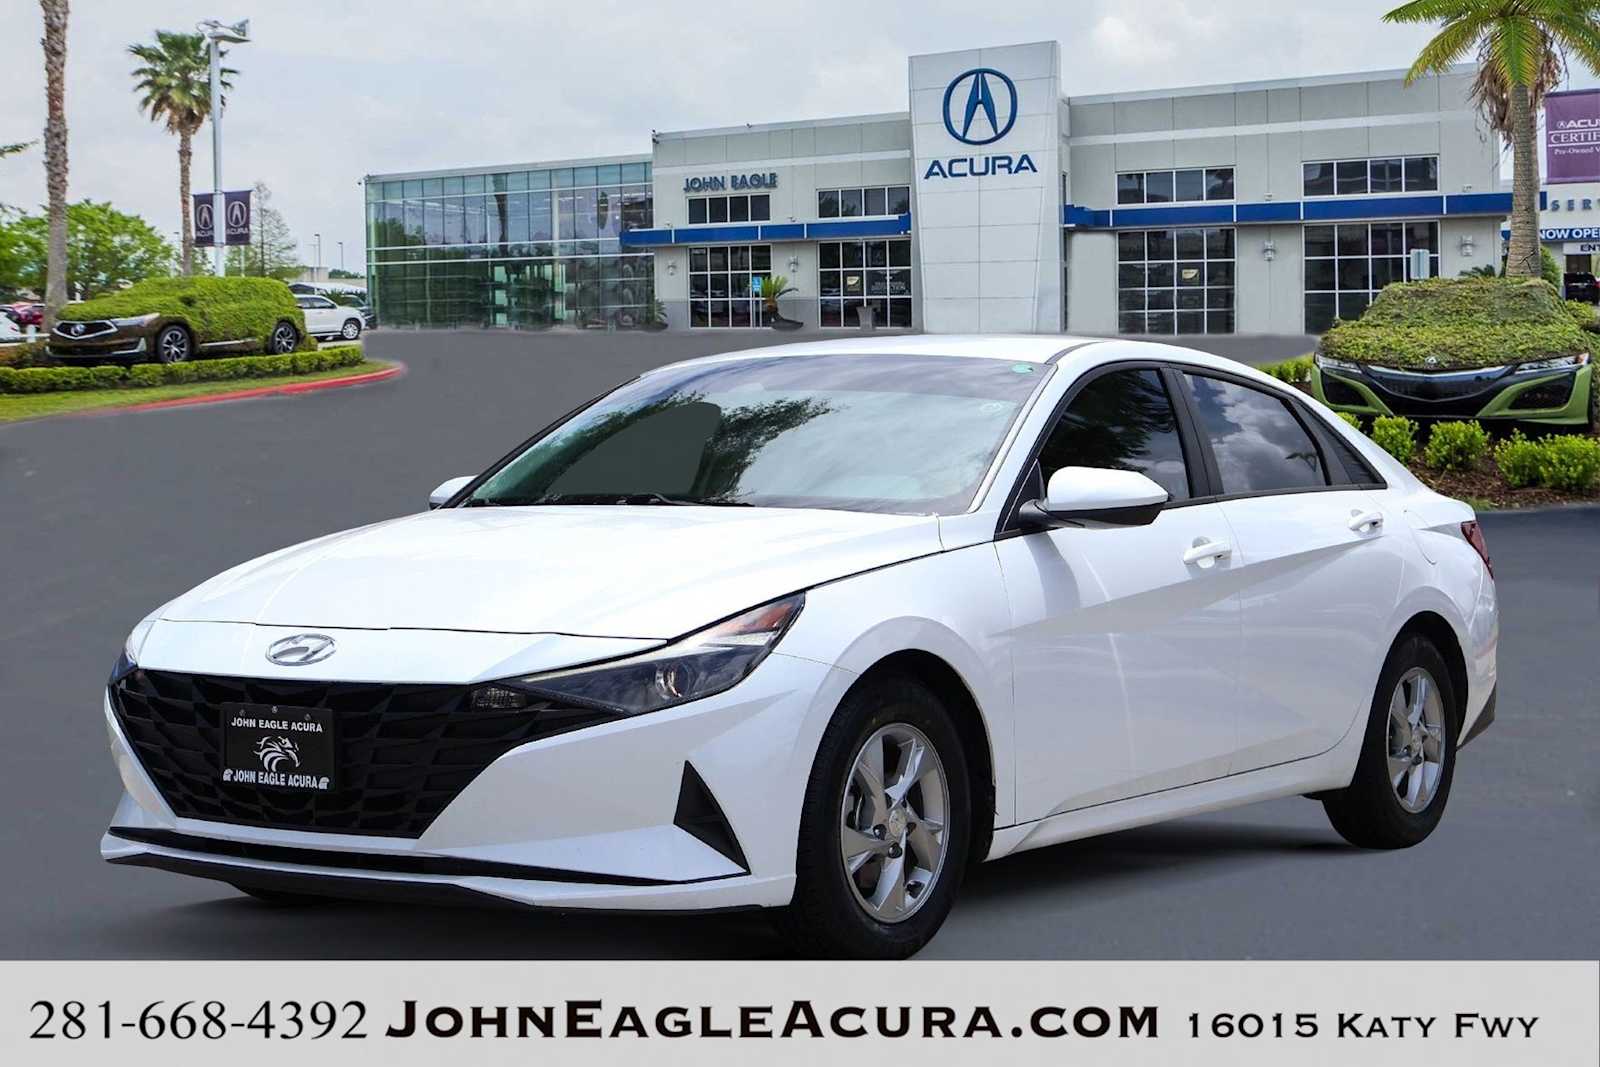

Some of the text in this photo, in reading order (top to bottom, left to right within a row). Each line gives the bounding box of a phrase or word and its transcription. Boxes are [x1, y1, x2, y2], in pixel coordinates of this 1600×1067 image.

[1566, 119, 1600, 128] ACU
[923, 154, 1038, 179] ACURA
[683, 172, 778, 192] JOHN EAGLE
[1539, 228, 1600, 239] NOW OPE
[231, 717, 323, 733] JOHN EAGLE ACURA
[233, 769, 318, 789] JOHN EAGLE ACURA
